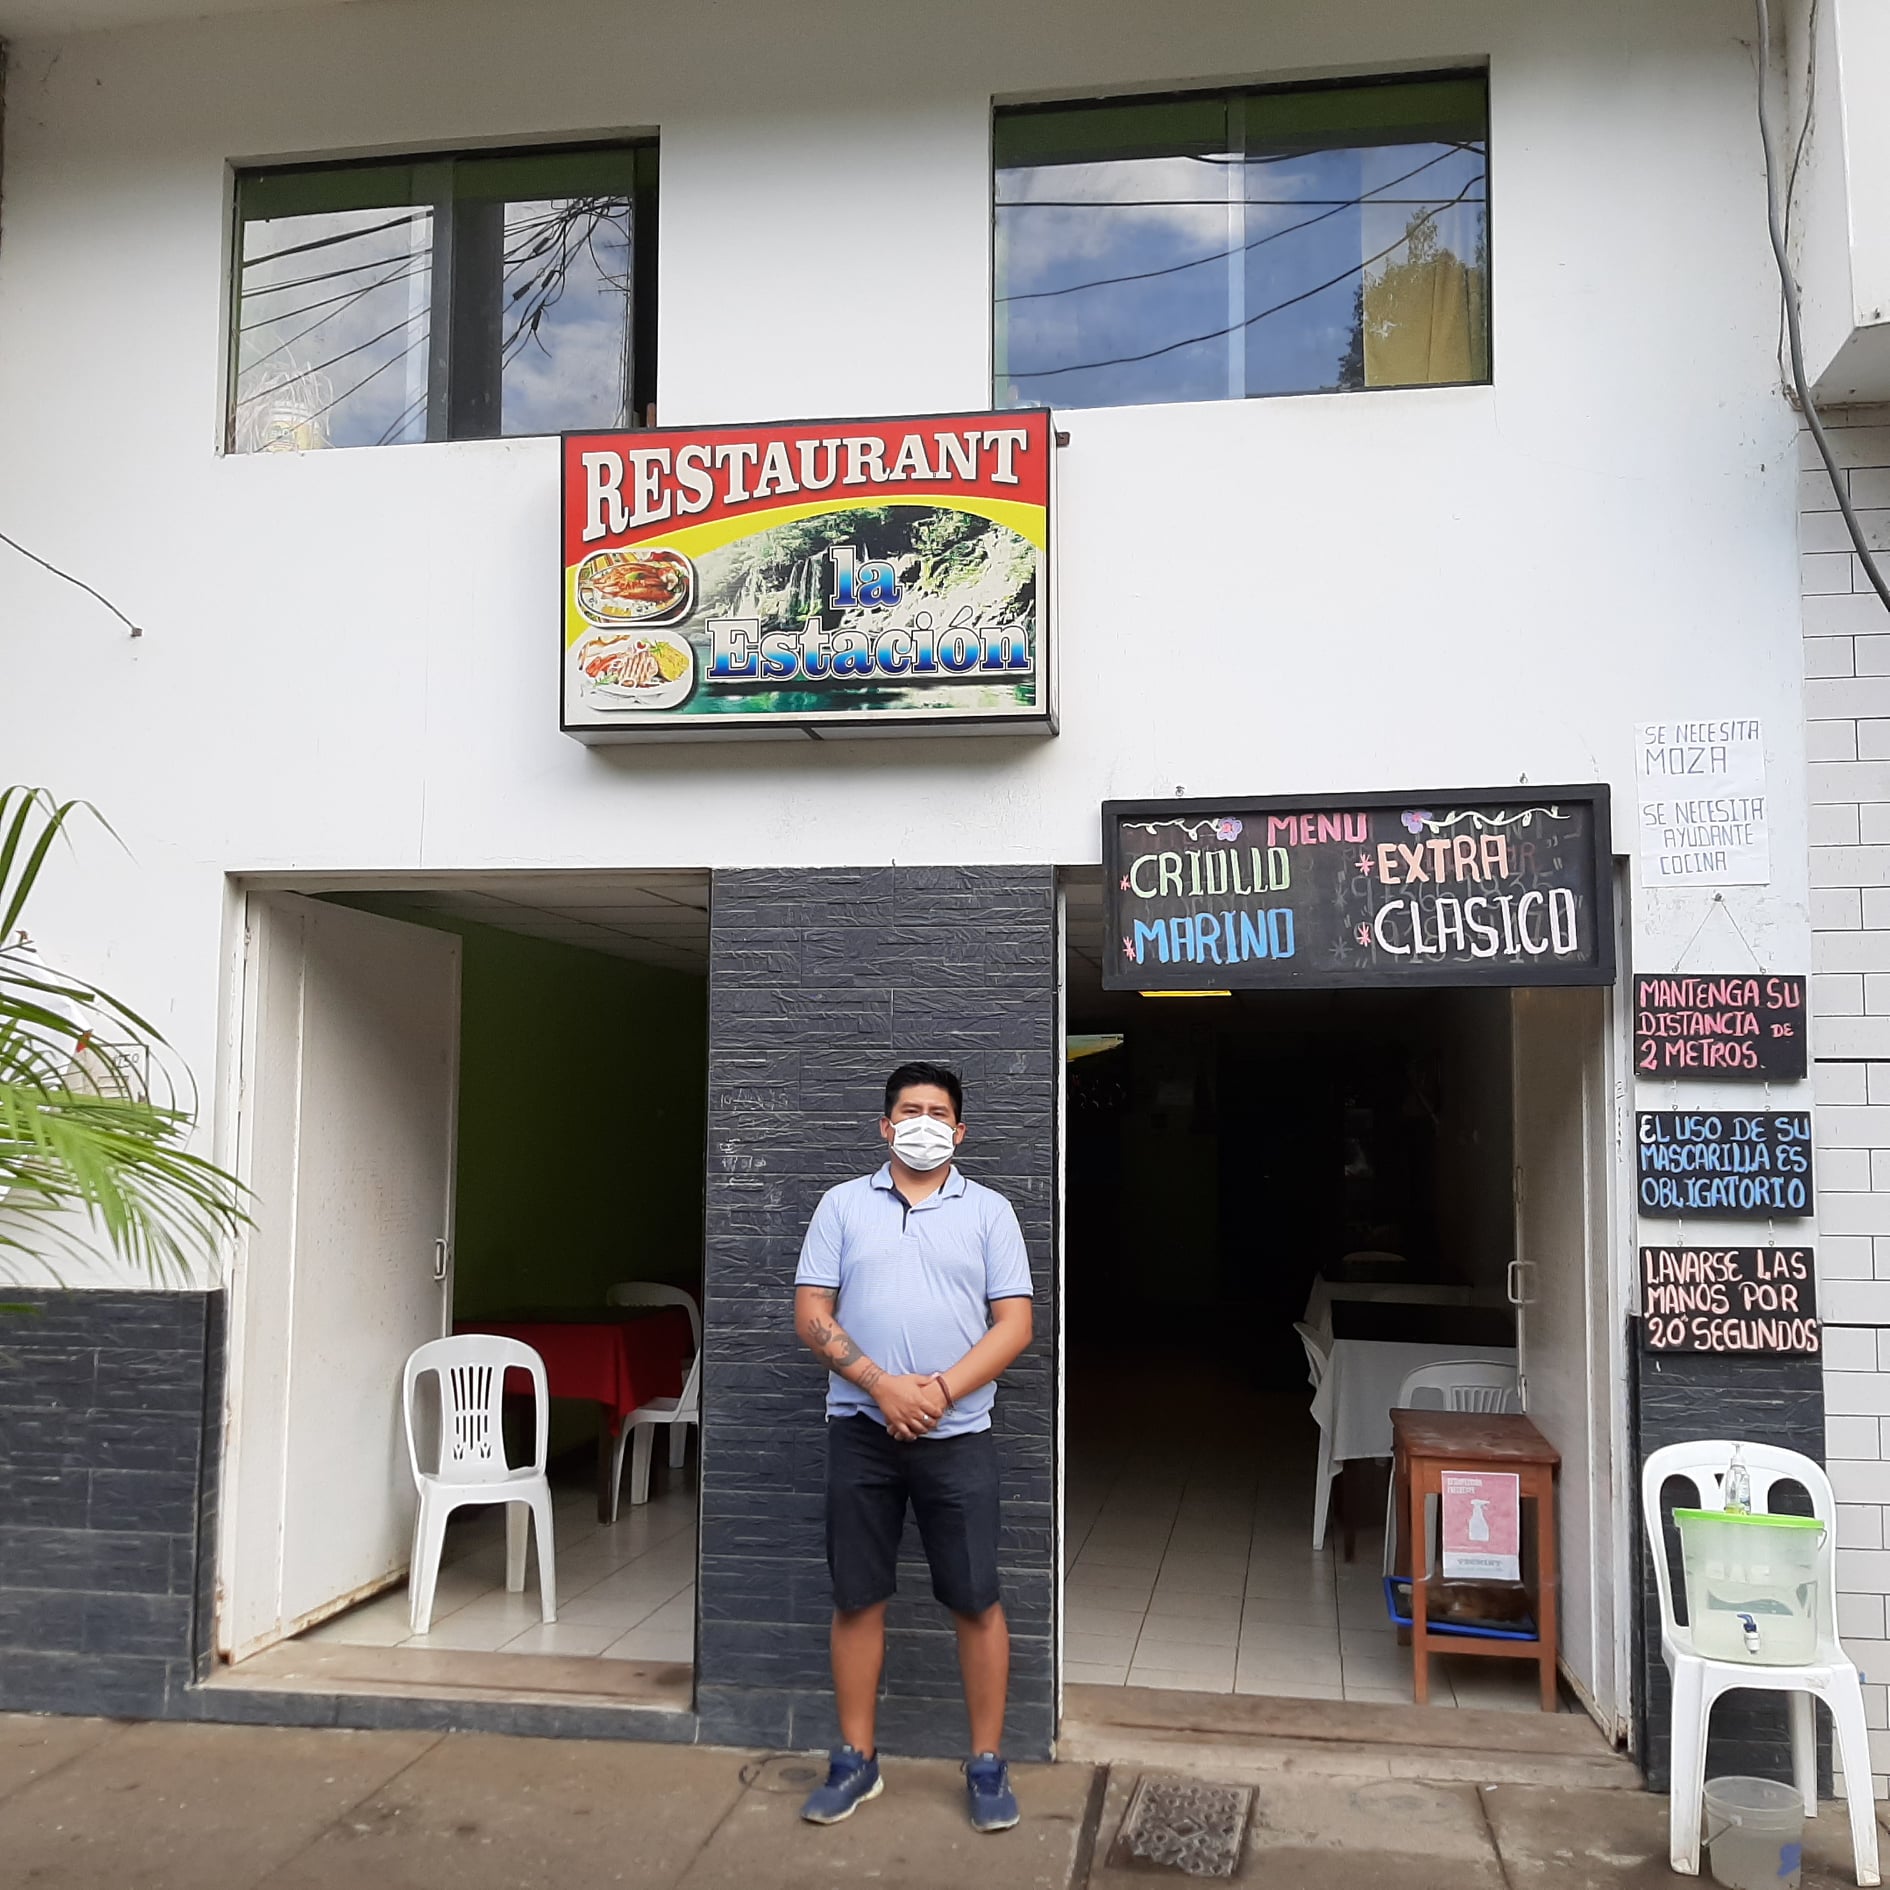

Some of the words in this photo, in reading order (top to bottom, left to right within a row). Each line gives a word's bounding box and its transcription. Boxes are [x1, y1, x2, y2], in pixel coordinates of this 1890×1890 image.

[581, 429, 1028, 543] RESTAURANT
[829, 545, 901, 610] la
[706, 606, 1032, 682] Estación
[1645, 726, 1666, 745] SE
[1676, 720, 1759, 744] NECESITA
[1646, 746, 1727, 775] MOZA
[1642, 803, 1667, 826] SE
[1675, 797, 1765, 824] NECESITA
[1267, 813, 1368, 847] MENU
[1664, 823, 1754, 848] AYUDANTE
[1130, 846, 1291, 899] CRIOLLO
[1377, 834, 1510, 884] EXTRA
[1660, 851, 1728, 875] COCINA
[1133, 908, 1296, 965] MARINO
[1374, 888, 1579, 958] CLASICO
[1640, 978, 1760, 1009] MANTENGA
[1766, 977, 1801, 1009] SU
[1636, 1010, 1760, 1037] DISTANCIA
[1770, 1023, 1794, 1038] DE
[1639, 1040, 1658, 1070] 2
[1665, 1038, 1758, 1069] METROS
[1639, 1114, 1670, 1144] EL
[1675, 1115, 1722, 1142] USO
[1730, 1116, 1768, 1142] DE
[1774, 1117, 1811, 1142] SU
[1640, 1143, 1771, 1174] MASCARILLA
[1775, 1145, 1808, 1173] ES
[1641, 1176, 1806, 1209] OBLIGATORIO
[1645, 1249, 1743, 1284] LAVARSE
[1756, 1249, 1807, 1280] LAS
[1647, 1284, 1730, 1315] MANOS
[1738, 1281, 1799, 1313] POR
[1692, 1317, 1819, 1352] SEGUNDOS
